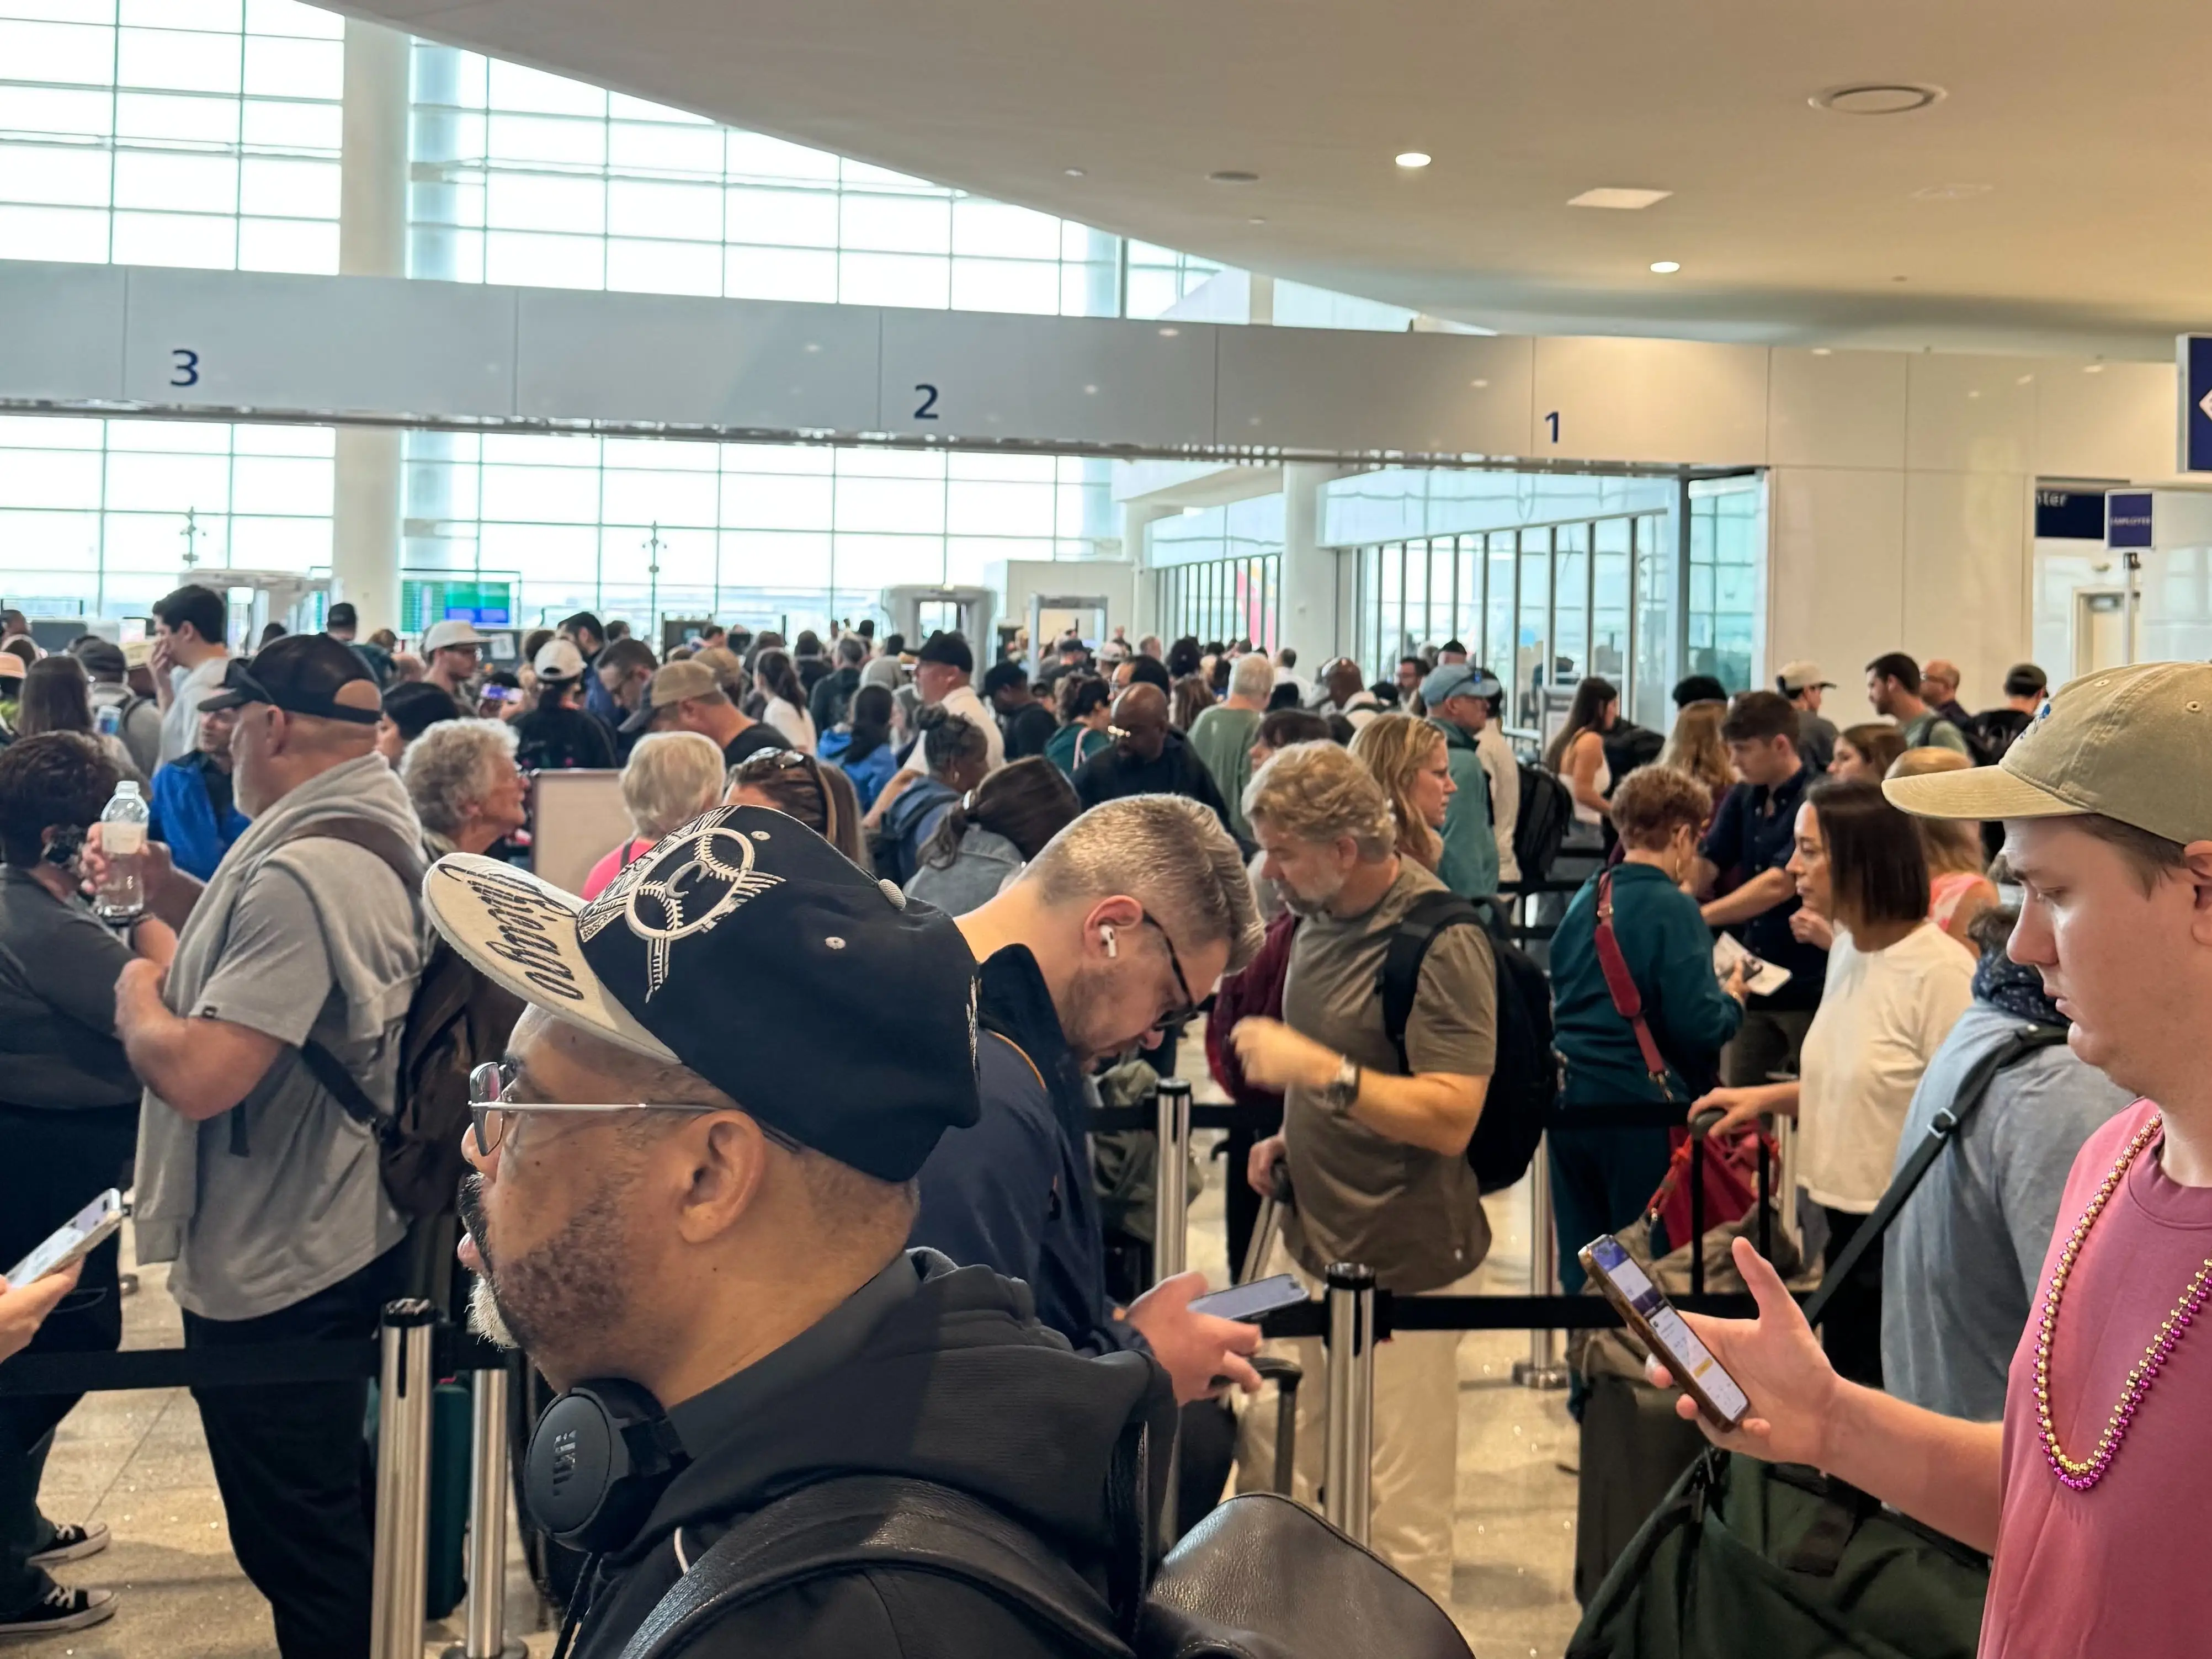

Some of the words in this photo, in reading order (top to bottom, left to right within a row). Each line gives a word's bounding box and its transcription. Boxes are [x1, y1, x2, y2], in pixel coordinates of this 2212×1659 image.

[171, 350, 198, 387] 3
[914, 384, 938, 419] 2
[1545, 411, 1558, 443] 1
[437, 863, 584, 1000] Chicago
